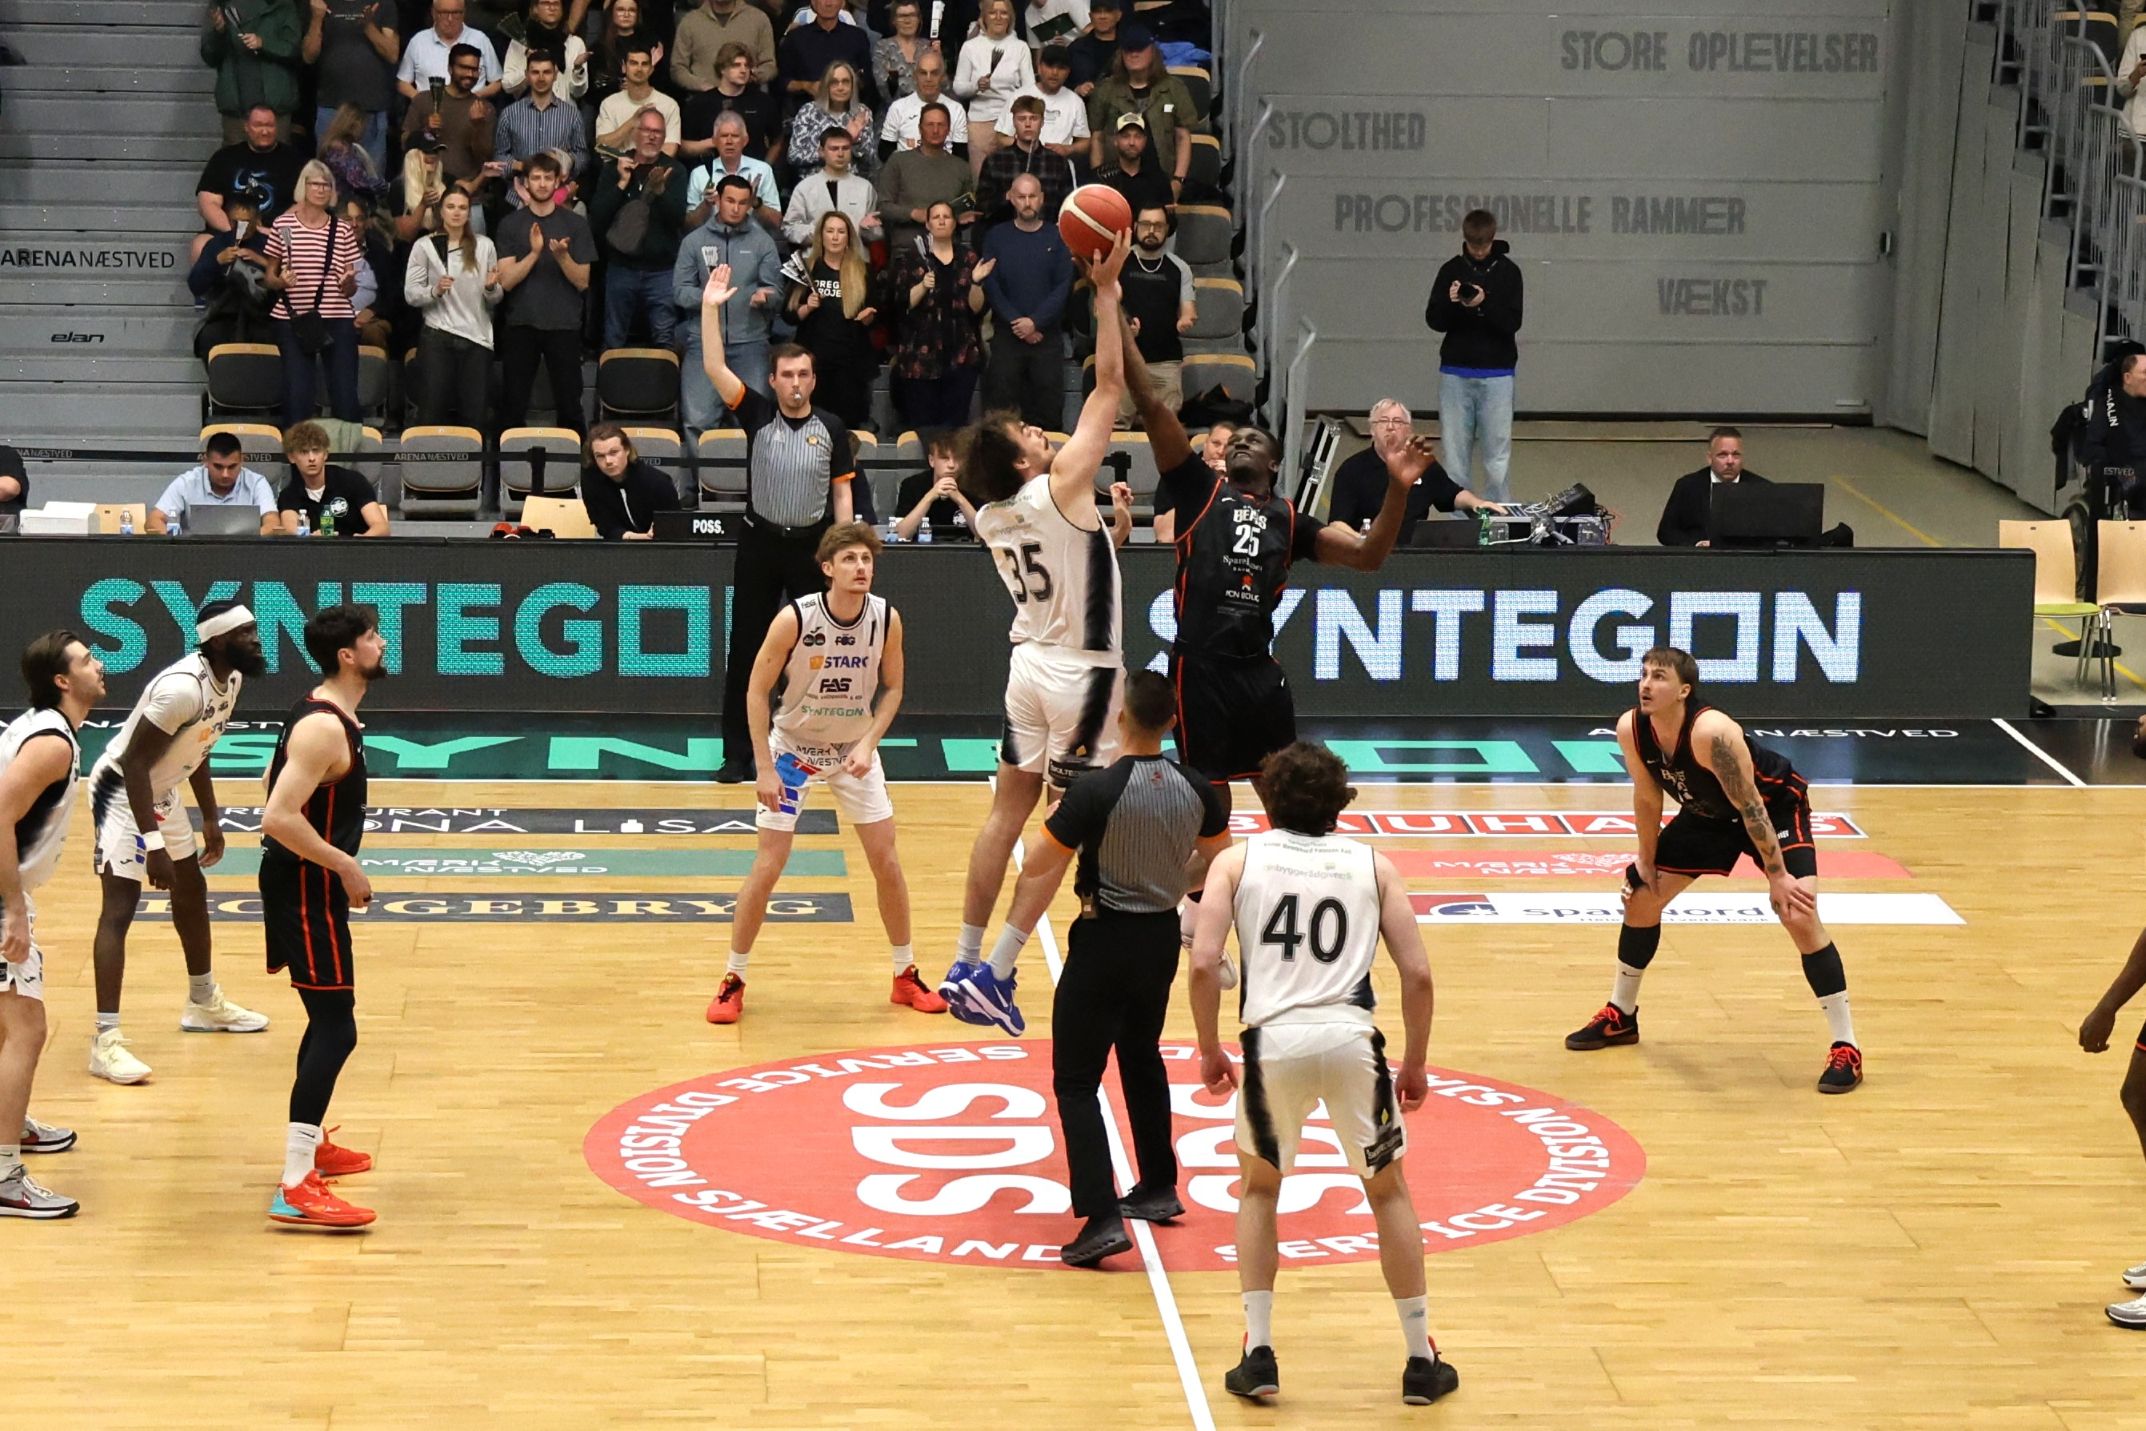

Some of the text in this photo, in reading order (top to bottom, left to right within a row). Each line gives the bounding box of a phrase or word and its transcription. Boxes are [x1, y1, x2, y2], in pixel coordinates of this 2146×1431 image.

[1561, 31, 1878, 72] STORE OPLEVELSER
[1269, 112, 1426, 150] STOLTHED
[1611, 197, 1746, 234] RAMMER
[1656, 278, 1768, 315] VÆKST
[51, 331, 105, 343] elan
[693, 518, 725, 535] POSS.
[1233, 524, 1261, 557] 25
[1002, 541, 1054, 604] 35
[80, 577, 734, 679] SYNTEGO
[801, 705, 864, 717] SYNTEGON
[1260, 892, 1350, 965] 40
[715, 1046, 1029, 1093] SERVICE
[620, 1091, 740, 1188] DIVISION
[842, 1082, 1073, 1216] SDS
[1500, 1107, 1610, 1205] DIVISION
[671, 1189, 1063, 1262] SJÆLLAND
